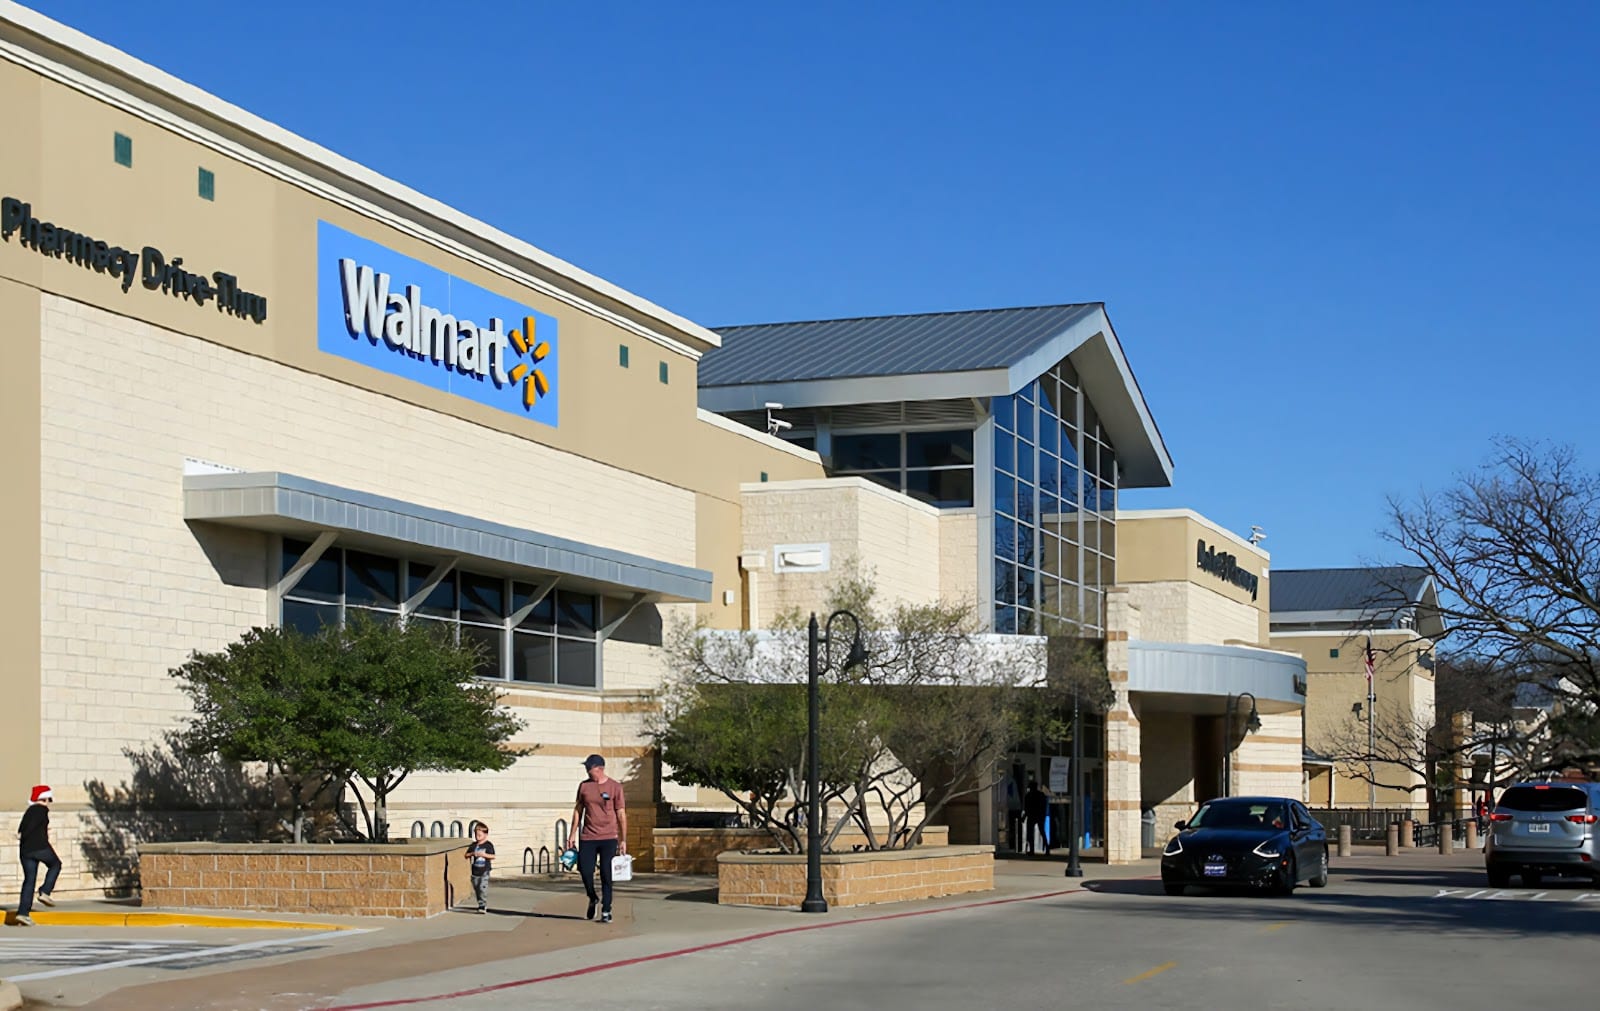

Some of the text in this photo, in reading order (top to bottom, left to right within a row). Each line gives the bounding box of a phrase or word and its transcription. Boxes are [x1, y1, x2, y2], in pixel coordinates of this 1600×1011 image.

[1, 197, 267, 324] Pharmacy Drive-Thru
[339, 258, 509, 387] Walmart
